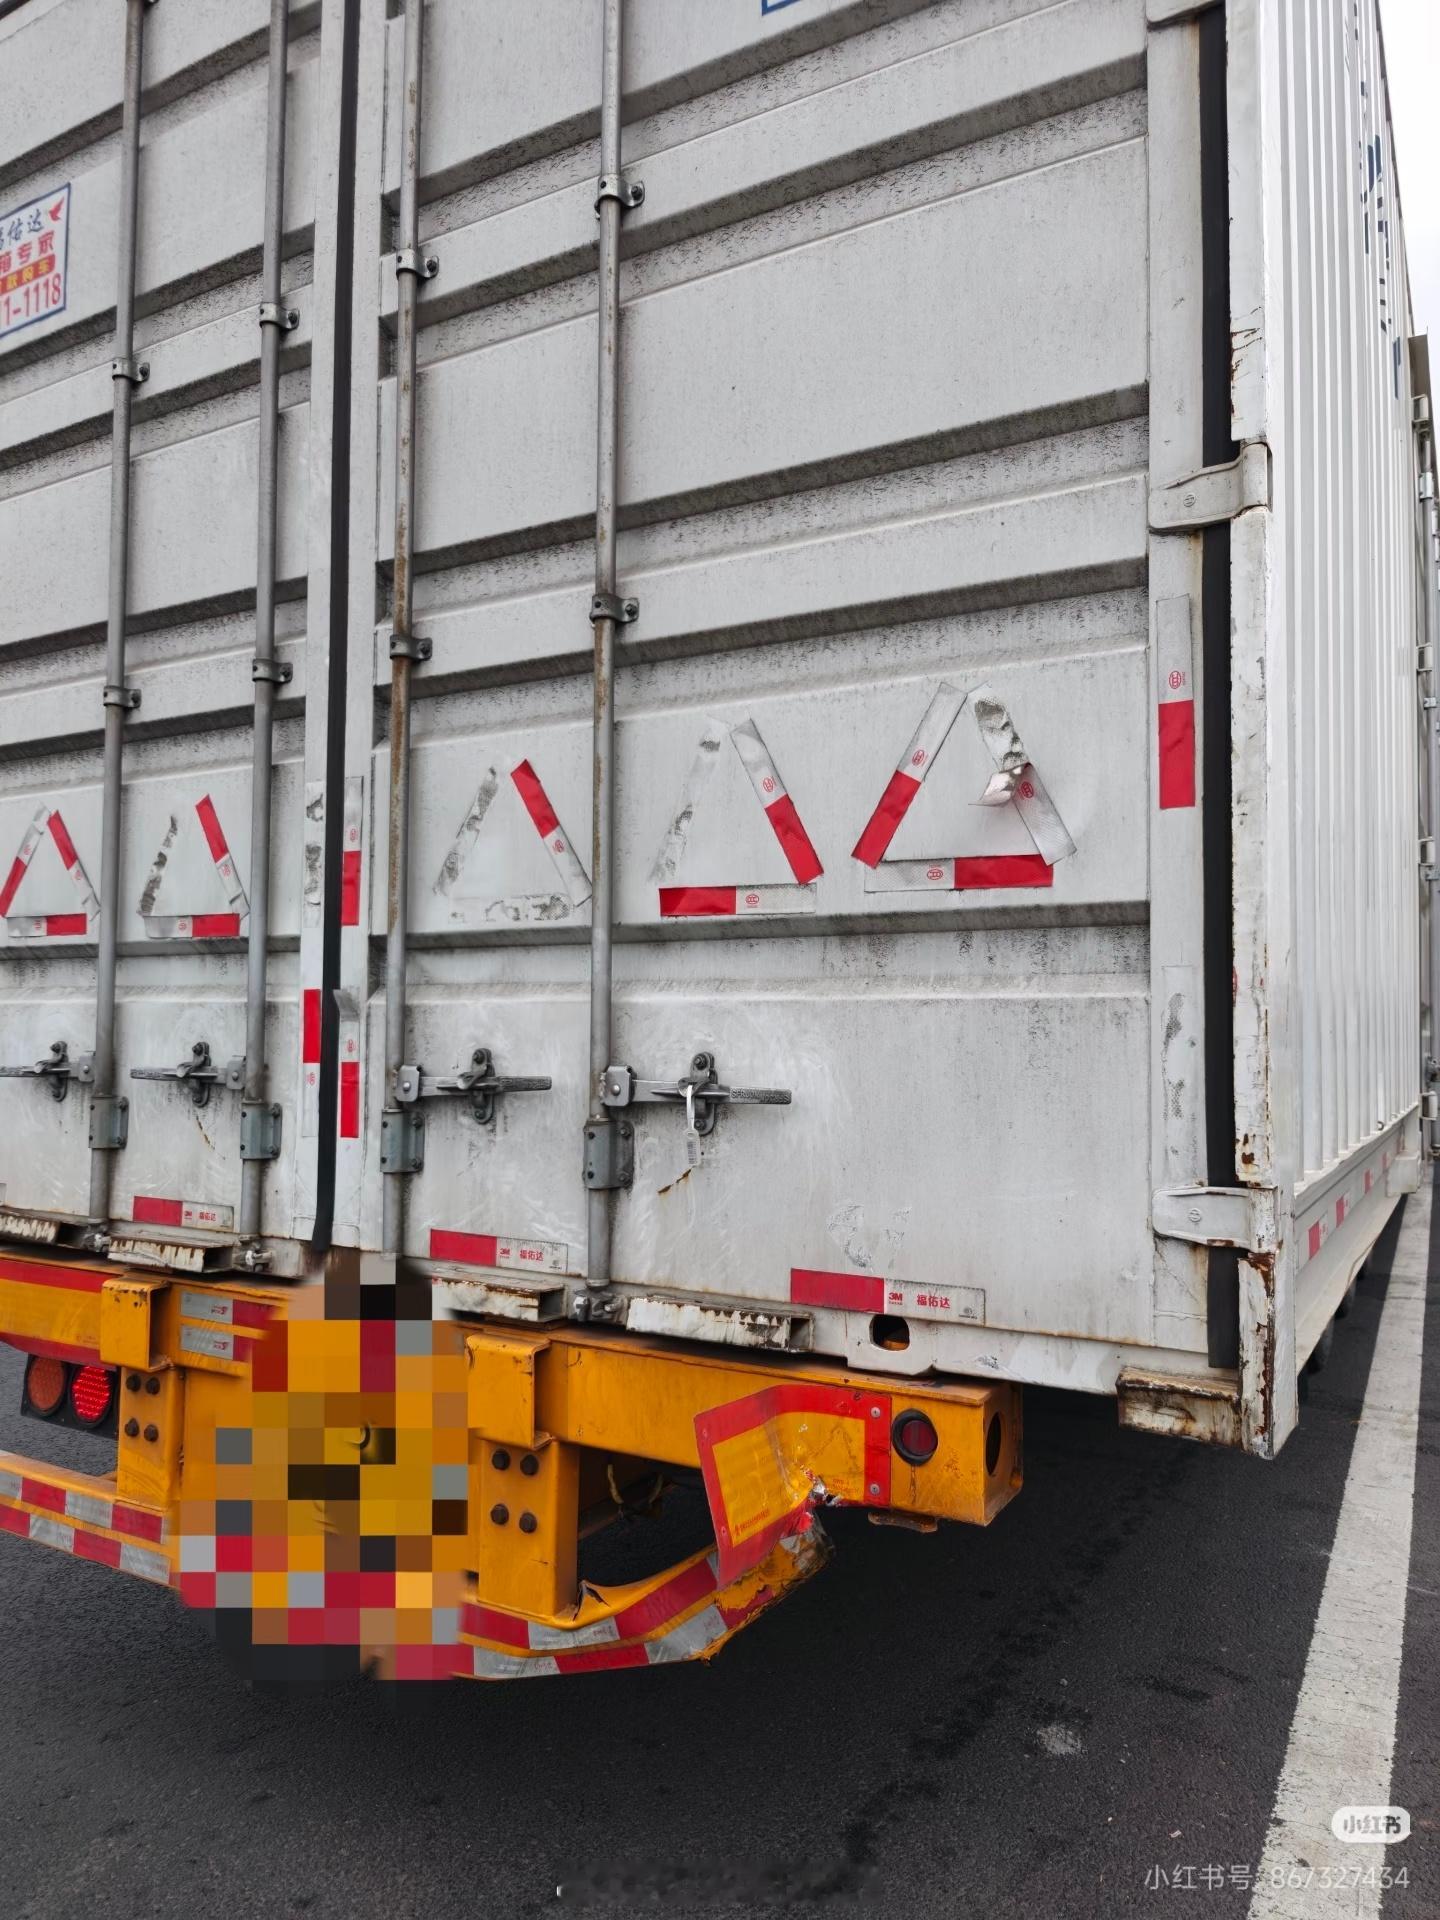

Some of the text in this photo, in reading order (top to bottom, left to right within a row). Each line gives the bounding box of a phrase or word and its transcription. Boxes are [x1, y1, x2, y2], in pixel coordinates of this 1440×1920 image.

[0, 208, 44, 250] 佑达
[0, 273, 62, 328] 1-1118
[888, 1292, 951, 1310] 3M 福佑达
